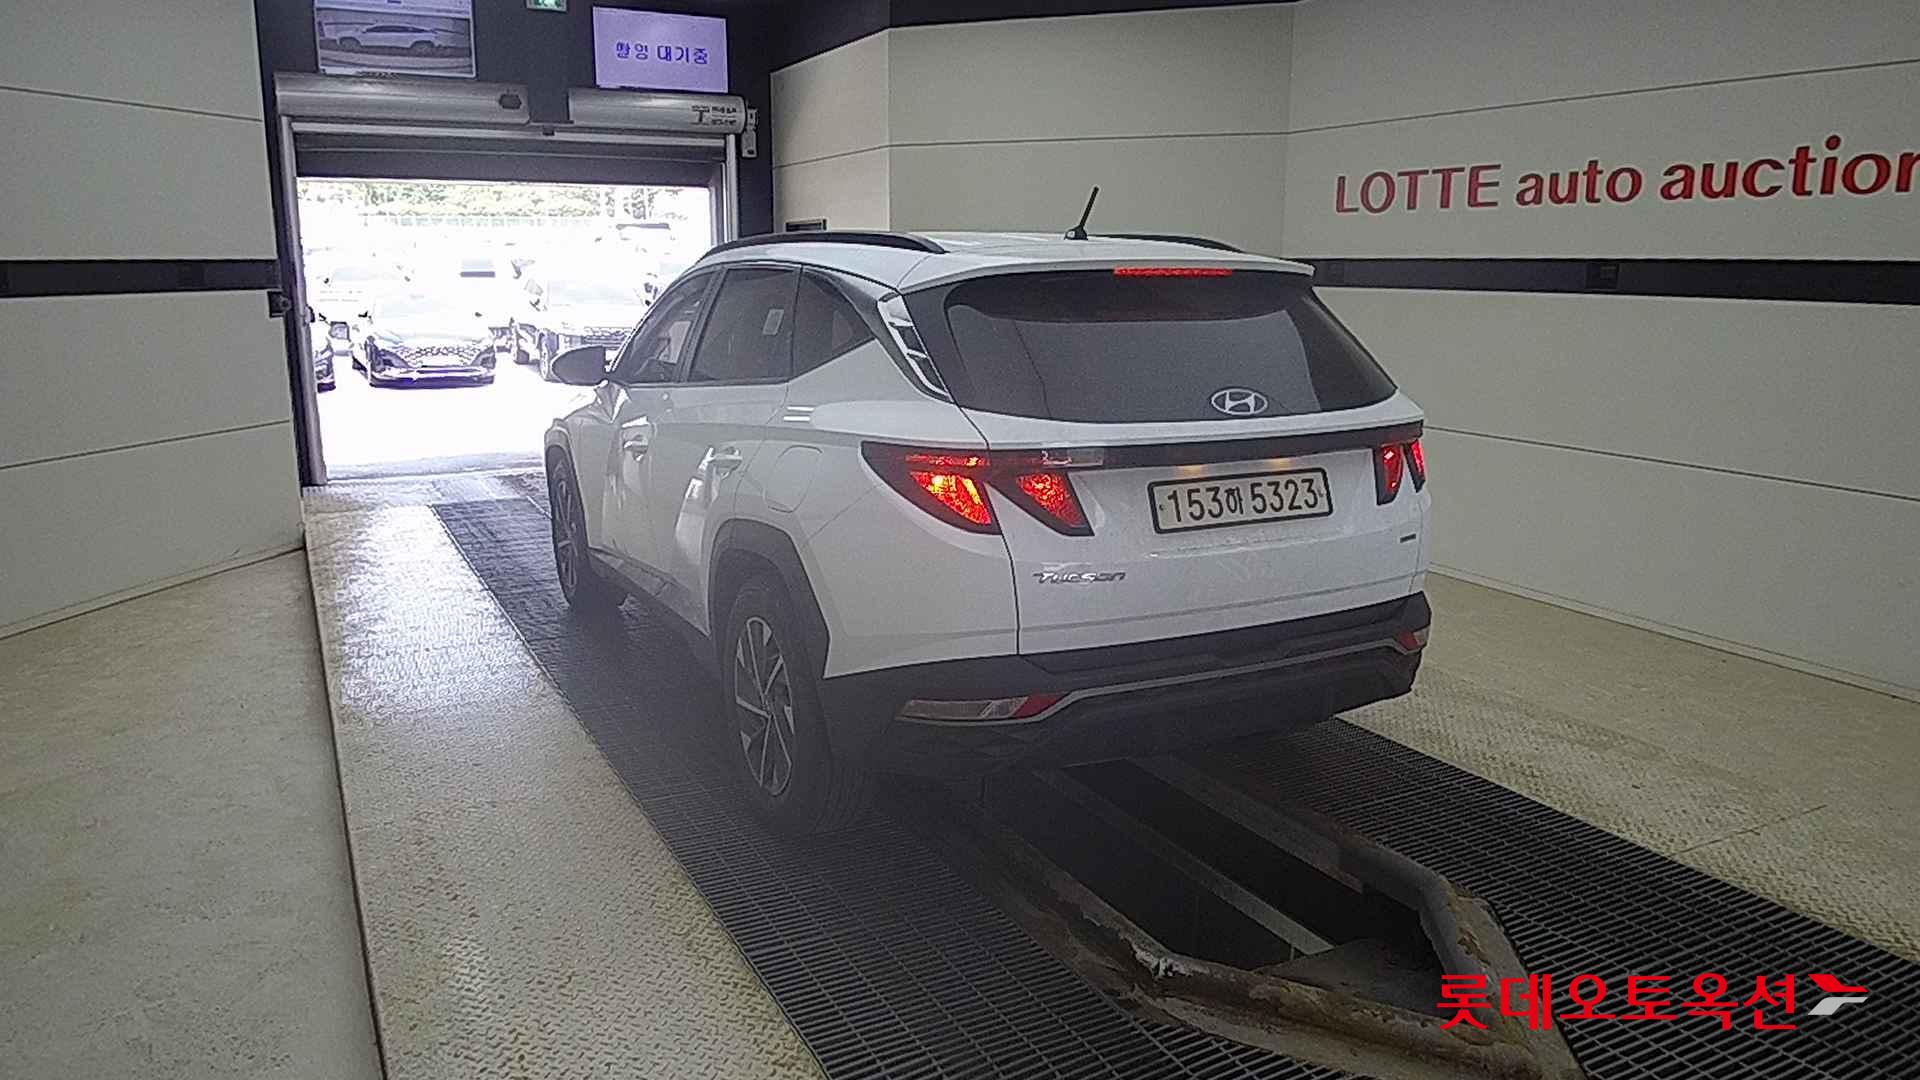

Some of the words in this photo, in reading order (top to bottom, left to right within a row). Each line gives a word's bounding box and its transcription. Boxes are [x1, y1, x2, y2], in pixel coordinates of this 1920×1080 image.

[657, 45, 708, 65] 대기중
[1335, 163, 1501, 214] LOTTE
[1515, 160, 1643, 207] auto
[1250, 478, 1318, 514] 5323
